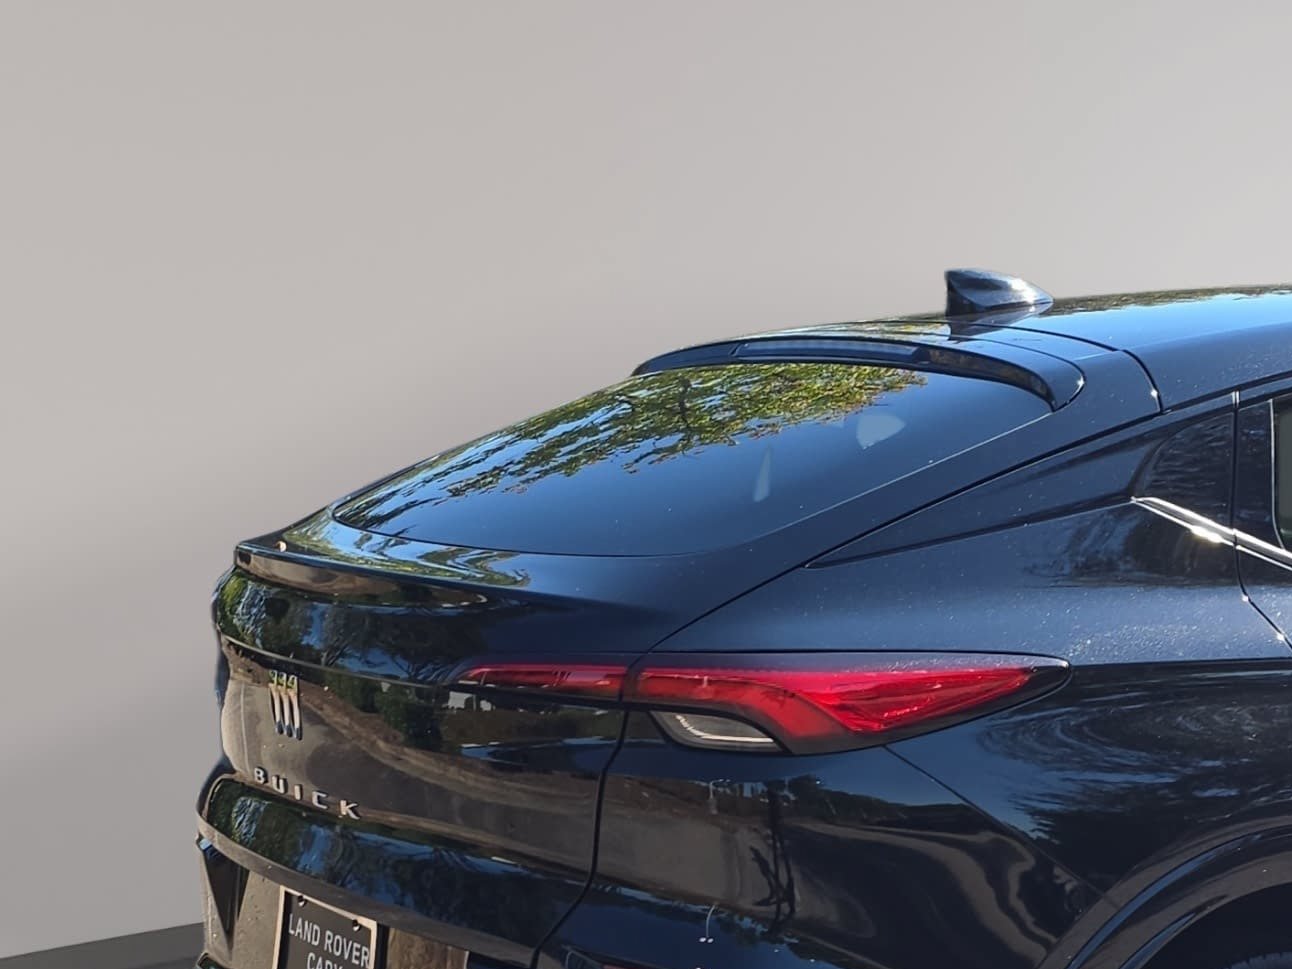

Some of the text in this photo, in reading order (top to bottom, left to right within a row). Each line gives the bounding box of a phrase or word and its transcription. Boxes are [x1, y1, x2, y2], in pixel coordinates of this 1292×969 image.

[253, 766, 361, 821] BUICK
[288, 913, 370, 969] LAND ROVER
